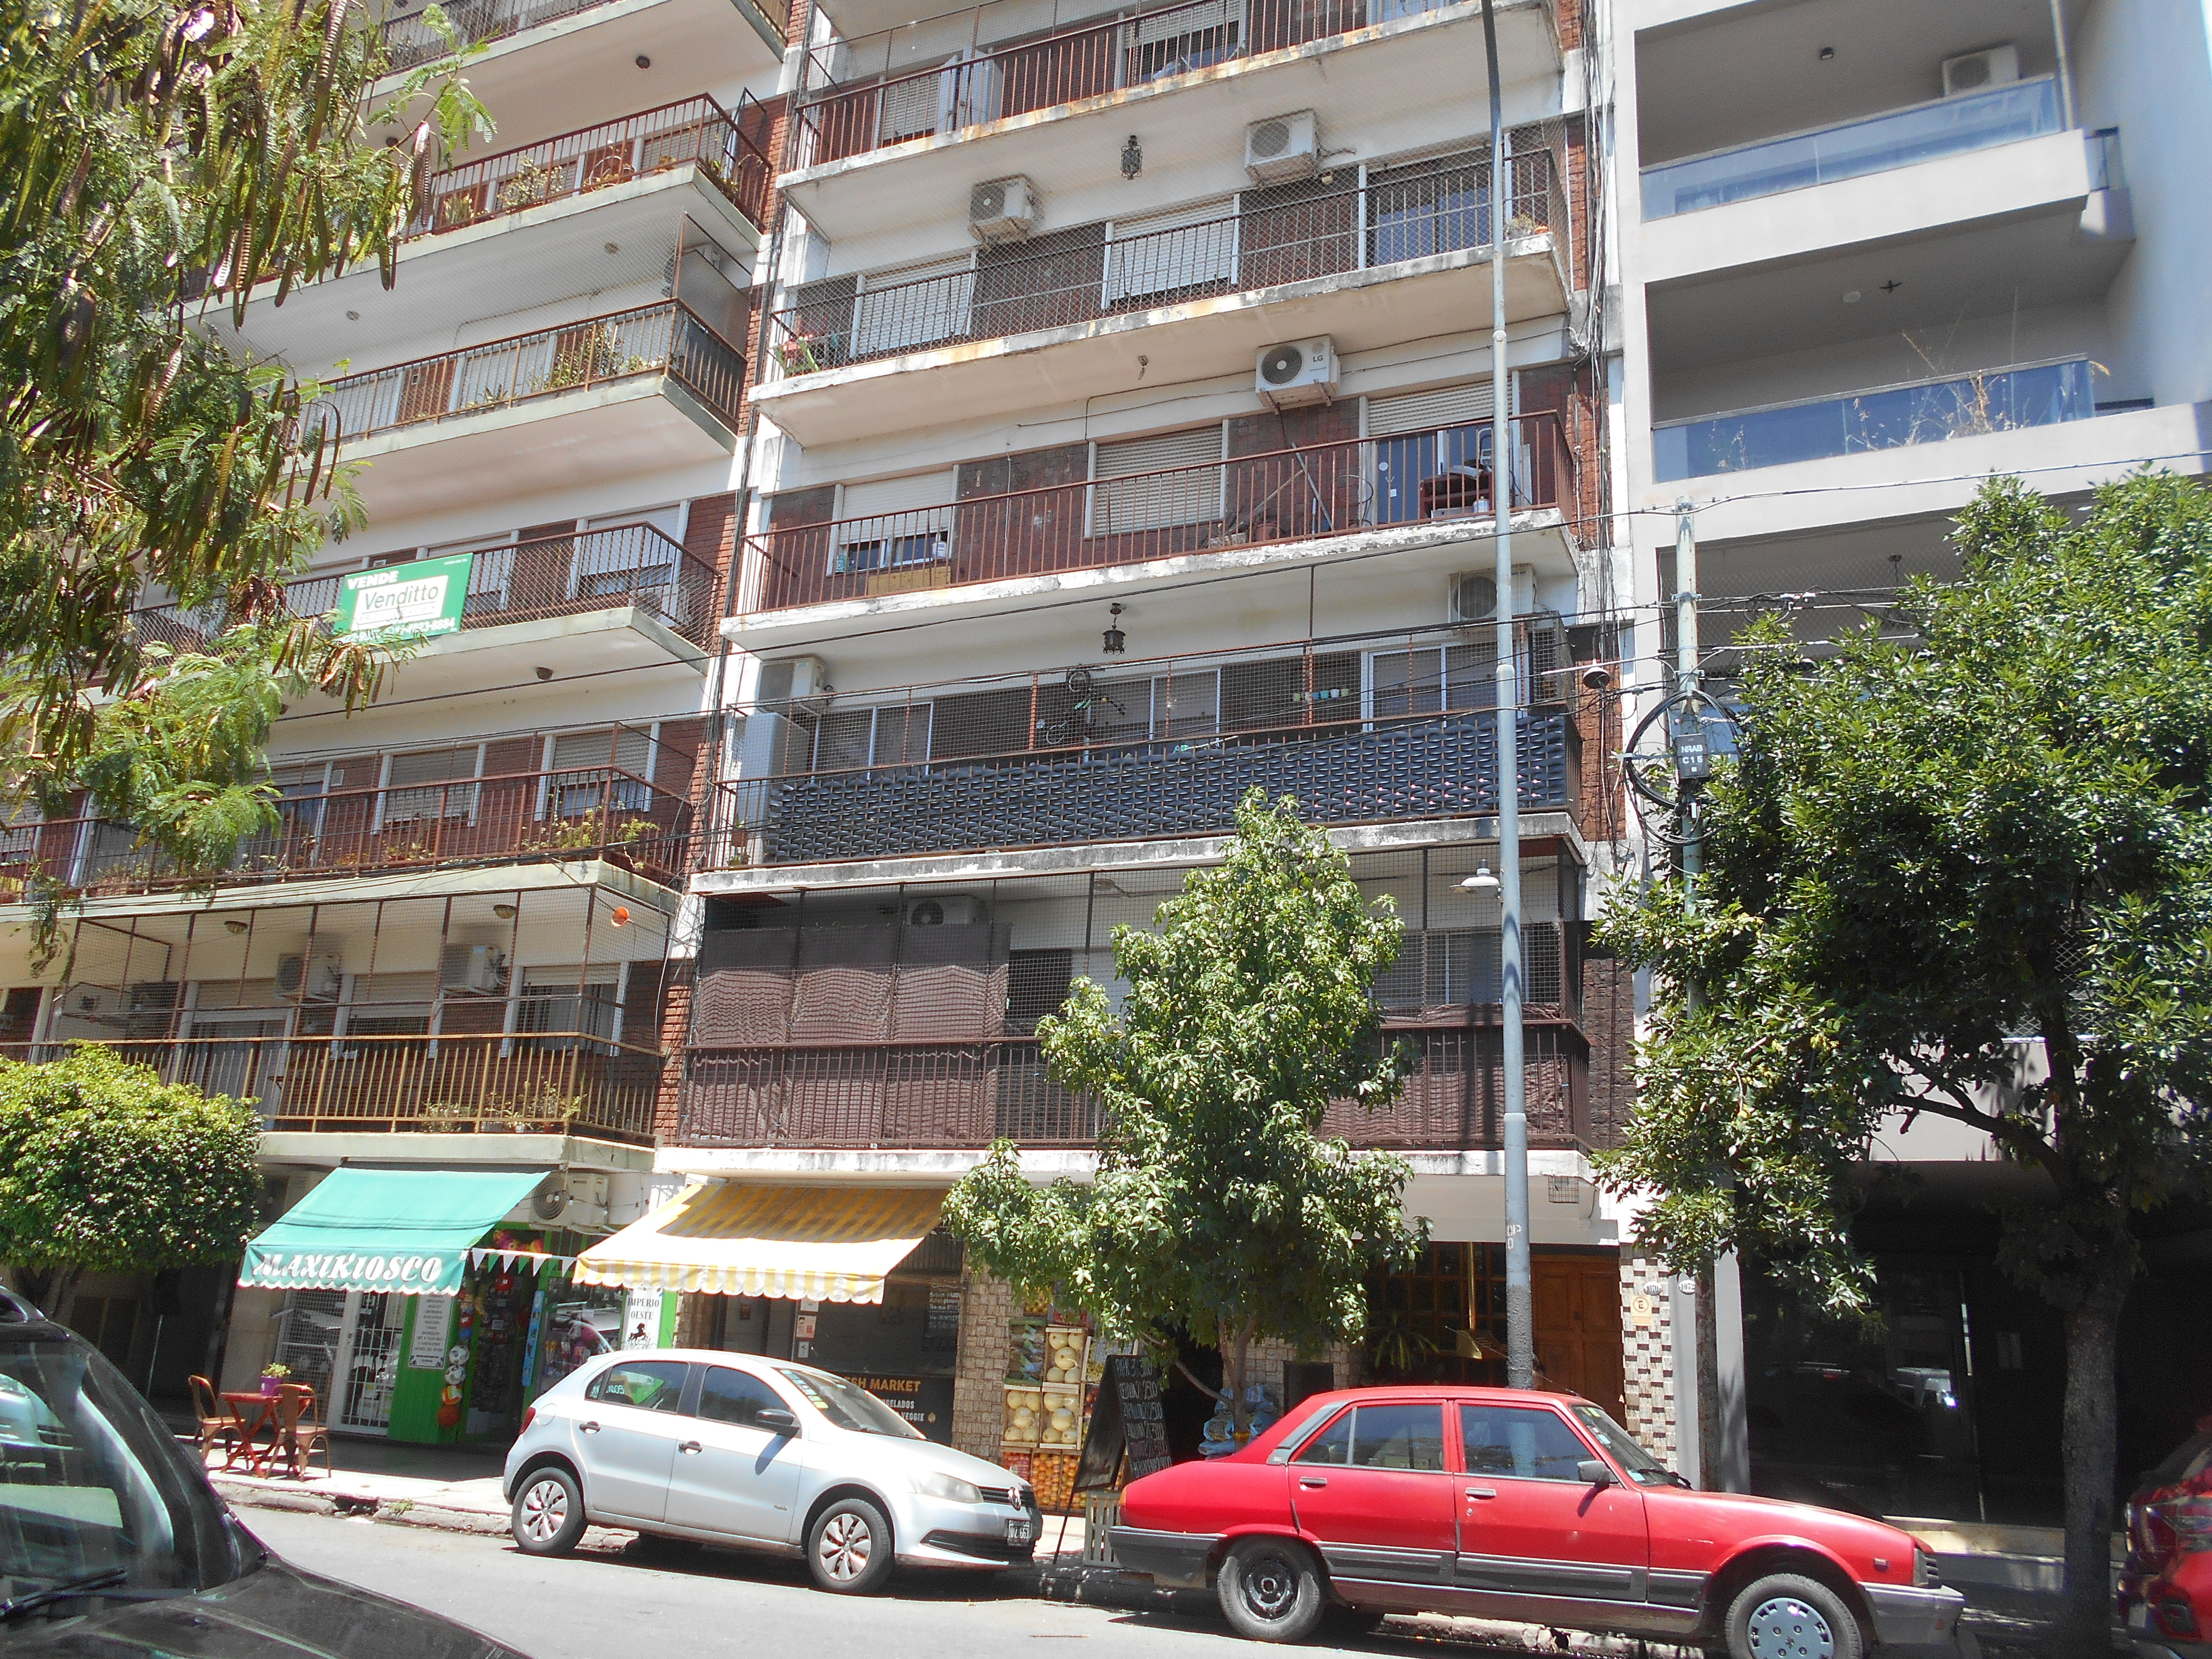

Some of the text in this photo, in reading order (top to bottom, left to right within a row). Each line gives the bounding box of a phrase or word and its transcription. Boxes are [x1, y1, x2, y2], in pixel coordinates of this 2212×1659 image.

[347, 571, 399, 590] VENDE
[365, 585, 438, 610] Venditto
[1681, 744, 1703, 753] NRAB
[252, 1252, 442, 1282] MAXIKIOSCO
[628, 1297, 659, 1307] IMPERIO
[631, 1311, 654, 1320] OESTE
[870, 1378, 921, 1392] MARKET
[901, 1412, 924, 1422] VEGGIE
